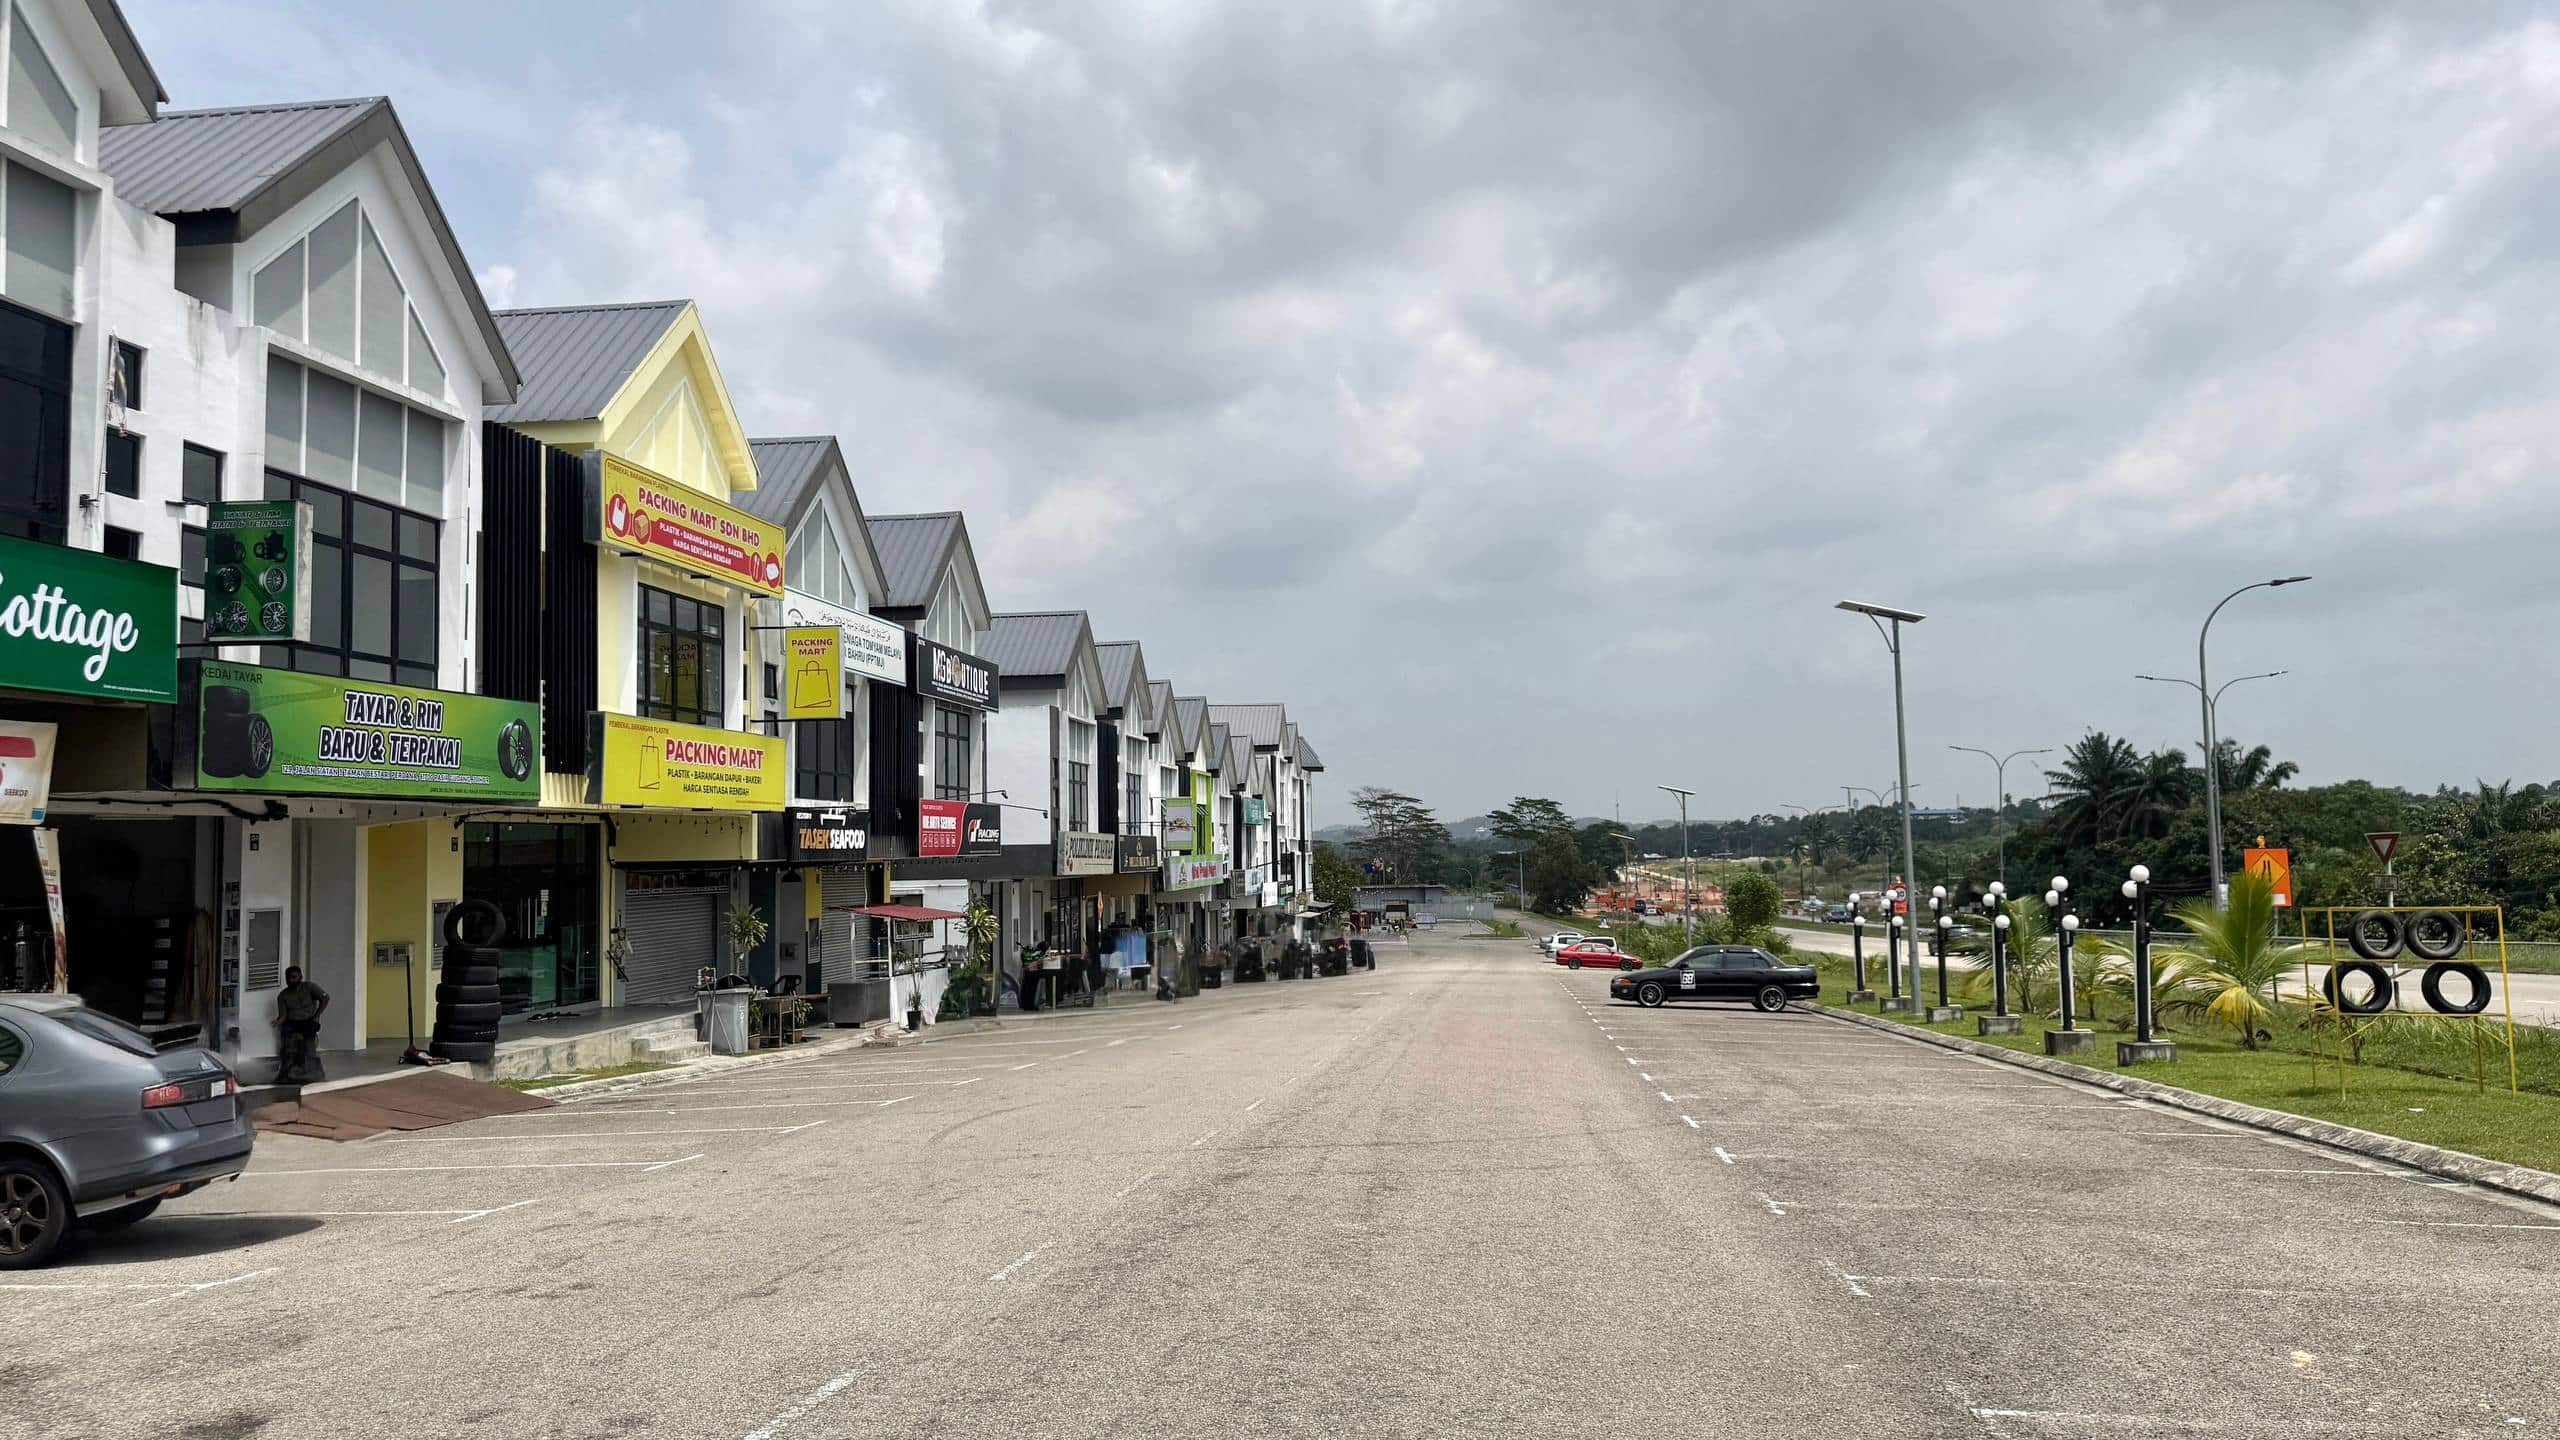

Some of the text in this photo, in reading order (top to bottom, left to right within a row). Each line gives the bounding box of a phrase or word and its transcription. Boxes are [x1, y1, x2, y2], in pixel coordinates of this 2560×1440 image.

[638, 487, 760, 548] PACKING MART SDN BHD
[659, 522, 680, 537] PLASTIK
[683, 530, 709, 547] BARANGAN
[672, 538, 690, 552] HARGA
[691, 544, 712, 560] SENTIASA
[0, 572, 139, 681] ottage
[792, 638, 832, 646] PACKING
[844, 632, 862, 647] ENIAGA
[799, 648, 826, 656] MART
[847, 648, 865, 662] BAHRU
[202, 668, 263, 684] KEDAI TAYAR
[344, 690, 444, 732] TAYAR & RIM
[318, 726, 462, 769] BARU & TERPAKAI
[666, 738, 764, 770] PACKING MART
[668, 768, 762, 784] PLASTIK BARANGAN DAPUR BAKERI
[683, 784, 750, 796] HARGA SENTIASA RENDAH
[800, 828, 866, 850] TASEK SEAFOOD
